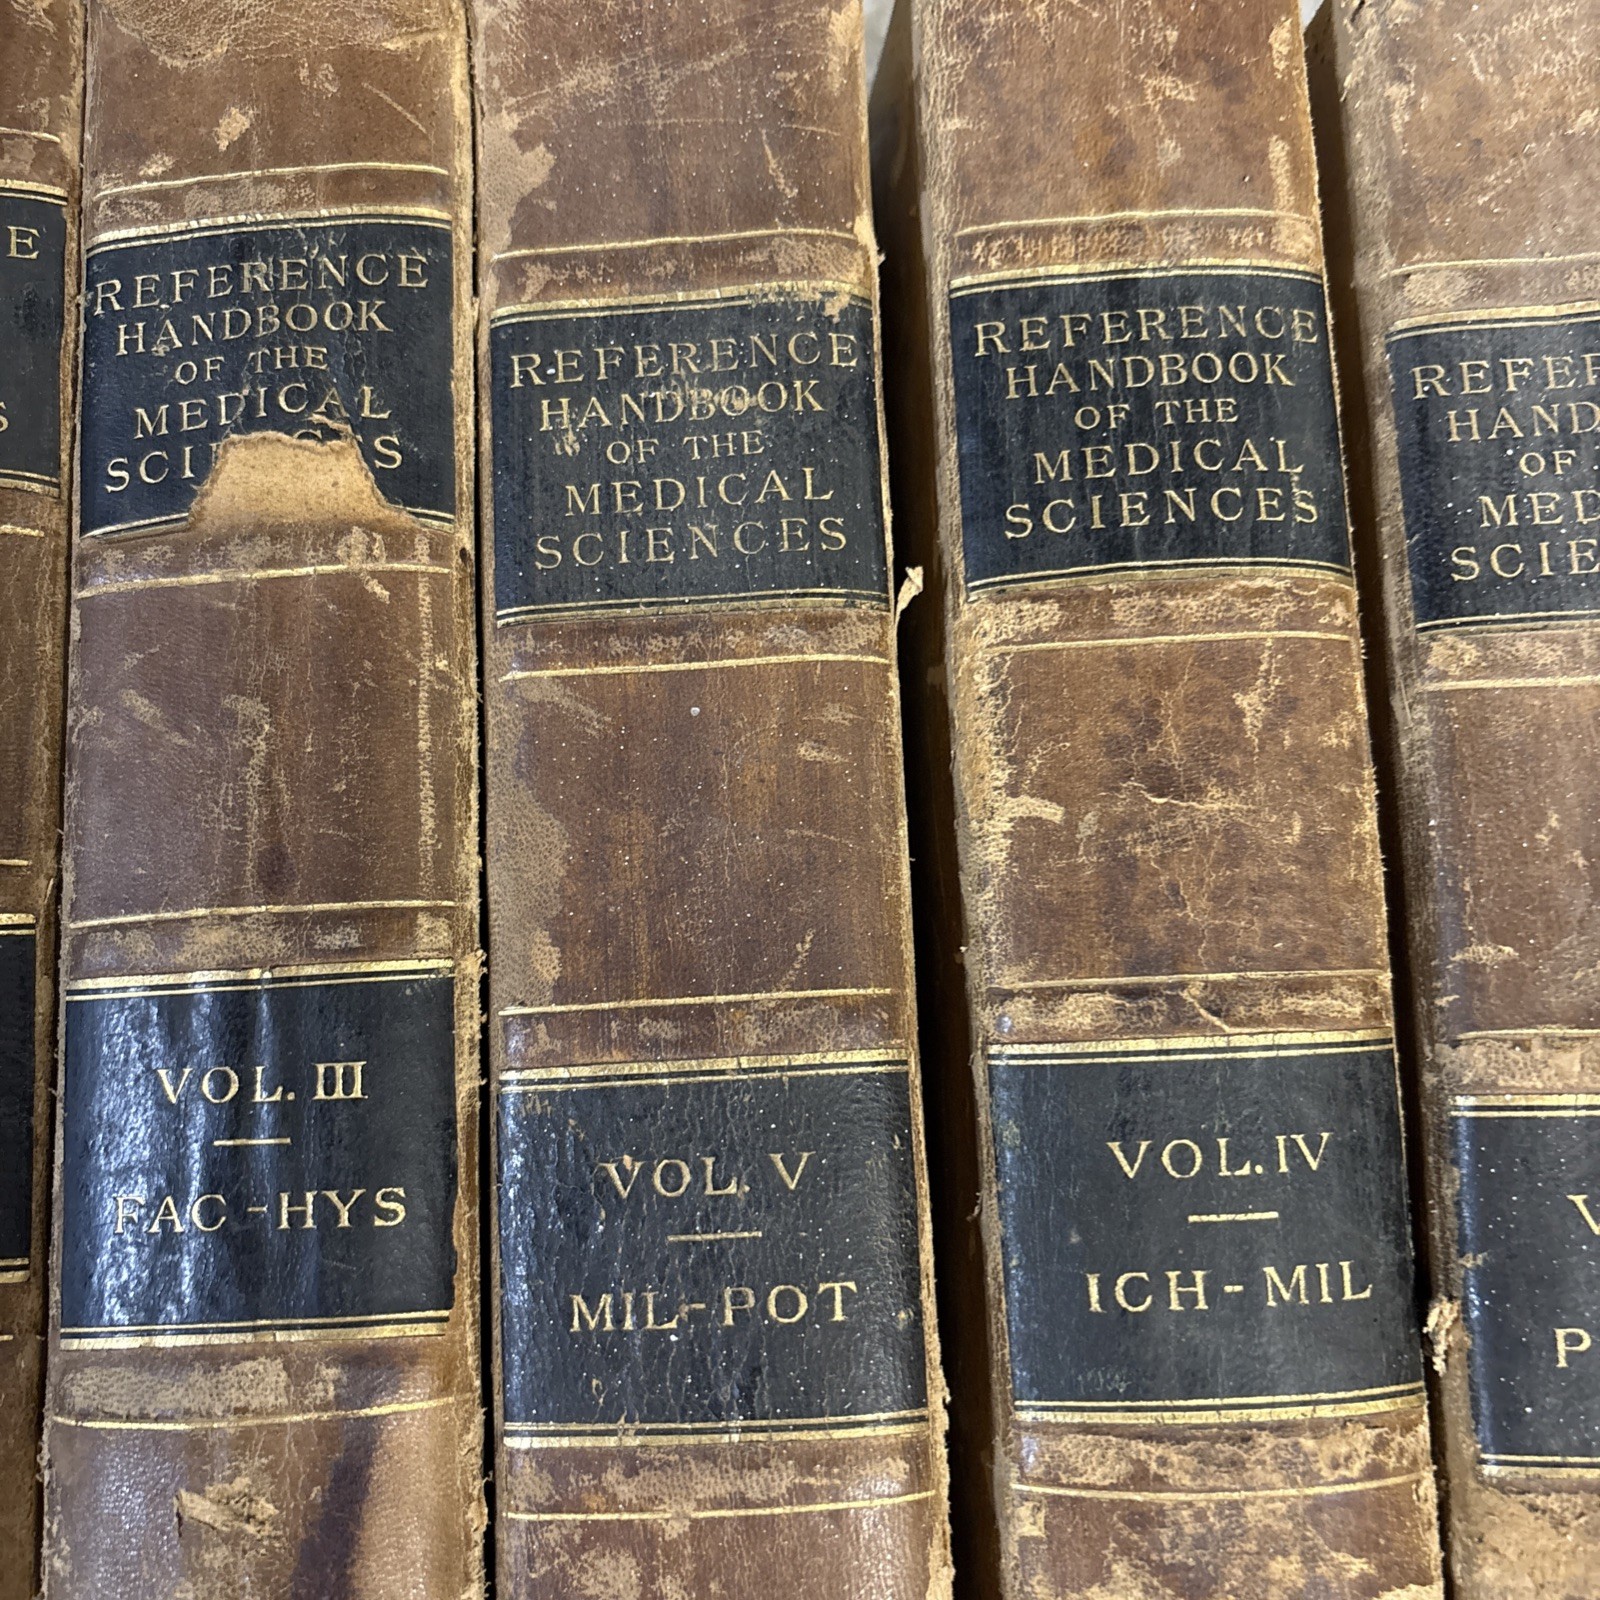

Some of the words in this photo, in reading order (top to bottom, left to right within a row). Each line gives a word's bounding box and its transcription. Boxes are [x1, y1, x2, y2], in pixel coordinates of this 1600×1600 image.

[93, 252, 430, 316] REFERENCE
[115, 299, 394, 357] HANDBOOK
[974, 304, 1319, 357] REFERENCE
[174, 355, 225, 386] OF
[248, 346, 329, 375] THE
[509, 331, 859, 389] REFERENCE
[1005, 351, 1296, 400] HANDBOOK
[132, 383, 393, 440] MEDICAL
[539, 379, 826, 432] HANDBOOK
[1073, 403, 1131, 430] OF
[1155, 397, 1239, 426] THE
[104, 429, 403, 493] SCIS
[606, 438, 660, 465] OF
[683, 429, 765, 461] THE
[1033, 438, 1304, 485] MEDICAL
[1518, 449, 1577, 477] OF
[565, 466, 835, 517] MEDICAL
[1004, 486, 1319, 539] SCIENCES
[535, 516, 848, 570] SCIENCES
[155, 1065, 296, 1104] VOL.
[312, 1060, 369, 1100] III
[600, 1155, 751, 1199] VOL.
[769, 1150, 816, 1191] V
[1106, 1136, 1264, 1179] VOL.
[1274, 1131, 1334, 1174] IV
[568, 1280, 858, 1333] MIL-POT
